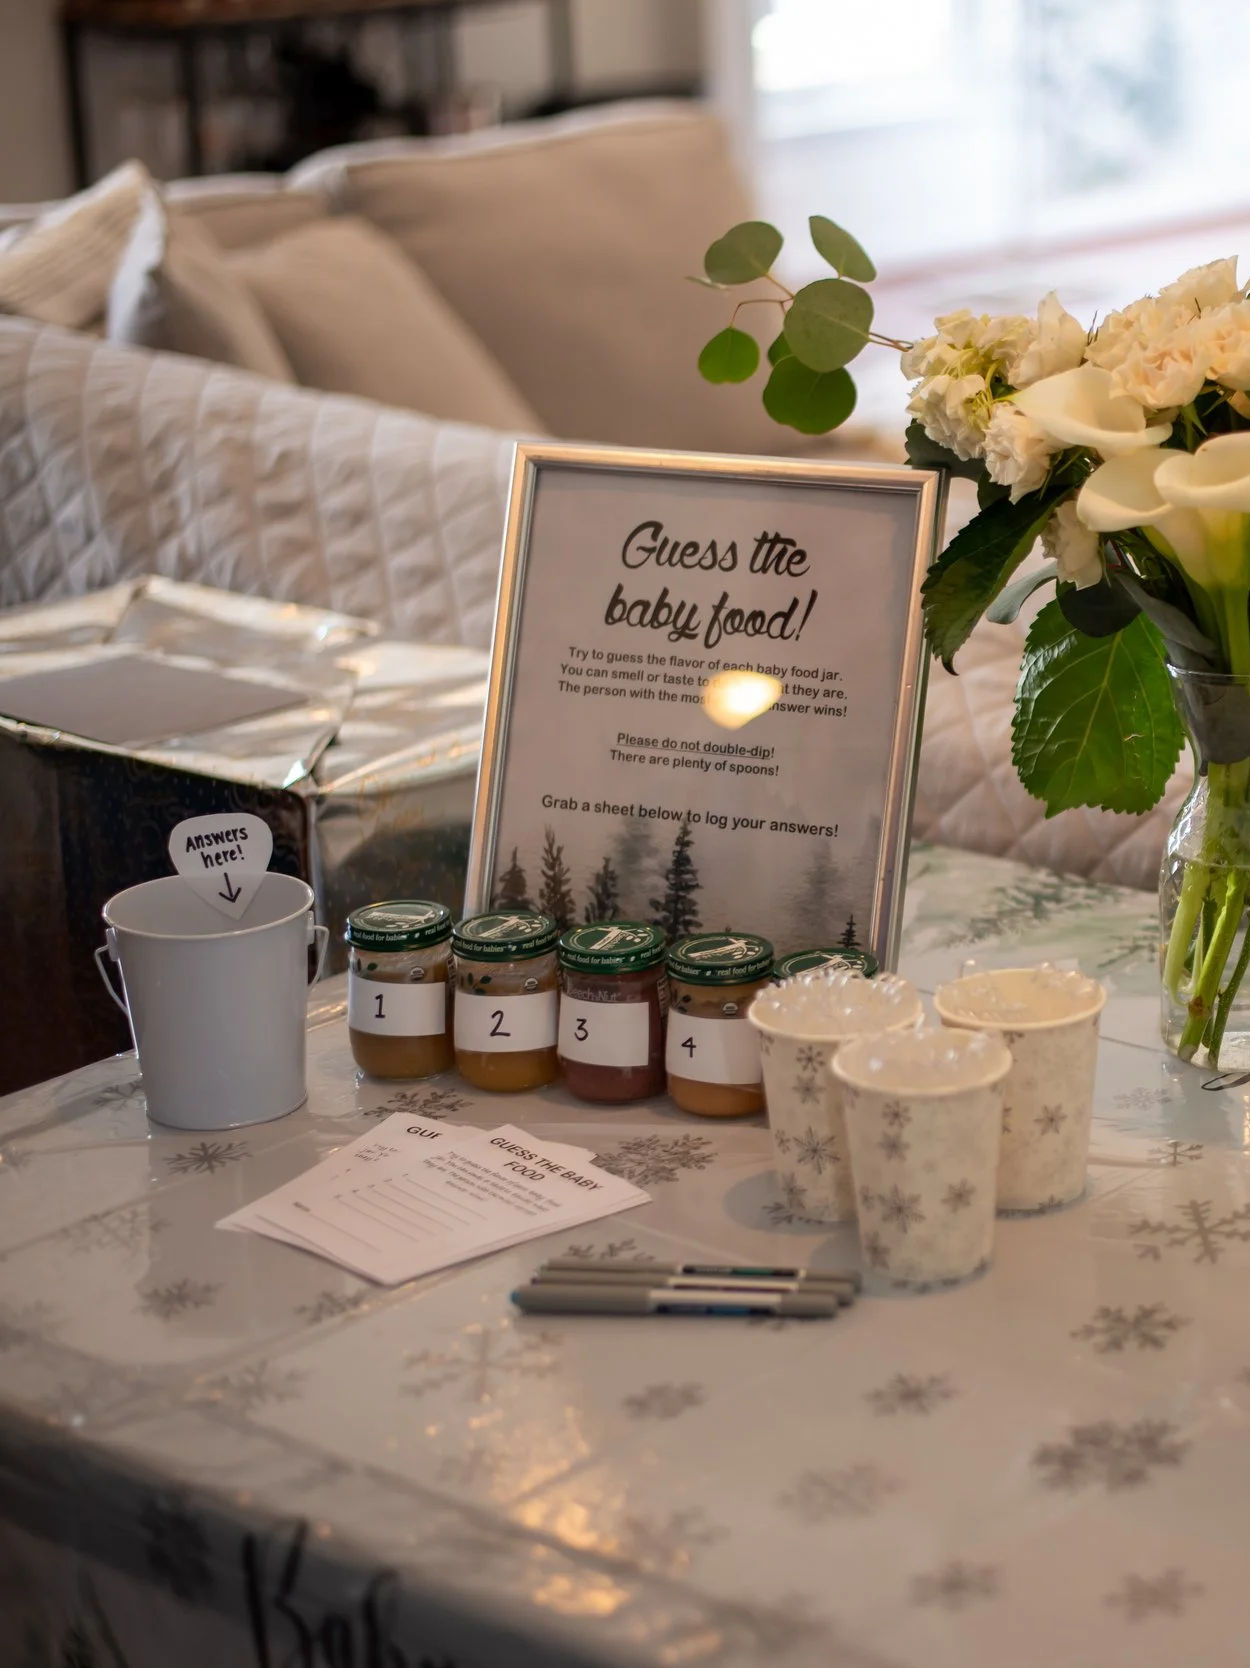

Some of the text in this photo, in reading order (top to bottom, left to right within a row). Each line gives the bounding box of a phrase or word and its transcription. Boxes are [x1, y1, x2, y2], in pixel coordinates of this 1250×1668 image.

[621, 520, 811, 578] Guess the
[604, 582, 818, 649] baby food!
[569, 646, 843, 683] Try to guess the flavor of each baby food jar.
[560, 663, 583, 676] You
[585, 667, 609, 679] can
[611, 669, 645, 681] smell
[646, 672, 661, 684] or
[663, 672, 695, 686] taste
[697, 675, 709, 688] to
[792, 684, 820, 700] they
[822, 688, 848, 700] are.
[558, 680, 581, 693] The
[583, 684, 627, 697] person
[629, 688, 655, 700] with
[658, 689, 678, 702] the
[769, 701, 811, 714] nswer
[813, 706, 848, 718] wins!
[617, 732, 775, 760] Please do not double-dip!
[610, 749, 780, 777] There are plenty of spoons!
[541, 794, 840, 838] Grab a sheet below to log your answers!
[185, 827, 249, 853] Answers
[200, 844, 245, 869] here!
[717, 968, 732, 976] real
[732, 965, 747, 975] food
[374, 993, 386, 1019] 1
[489, 1010, 511, 1037] 2
[574, 1018, 590, 1042] 3
[681, 1036, 697, 1058] 4
[490, 1137, 605, 1192] GUESS THE BABY
[503, 1160, 546, 1182] FOOD
